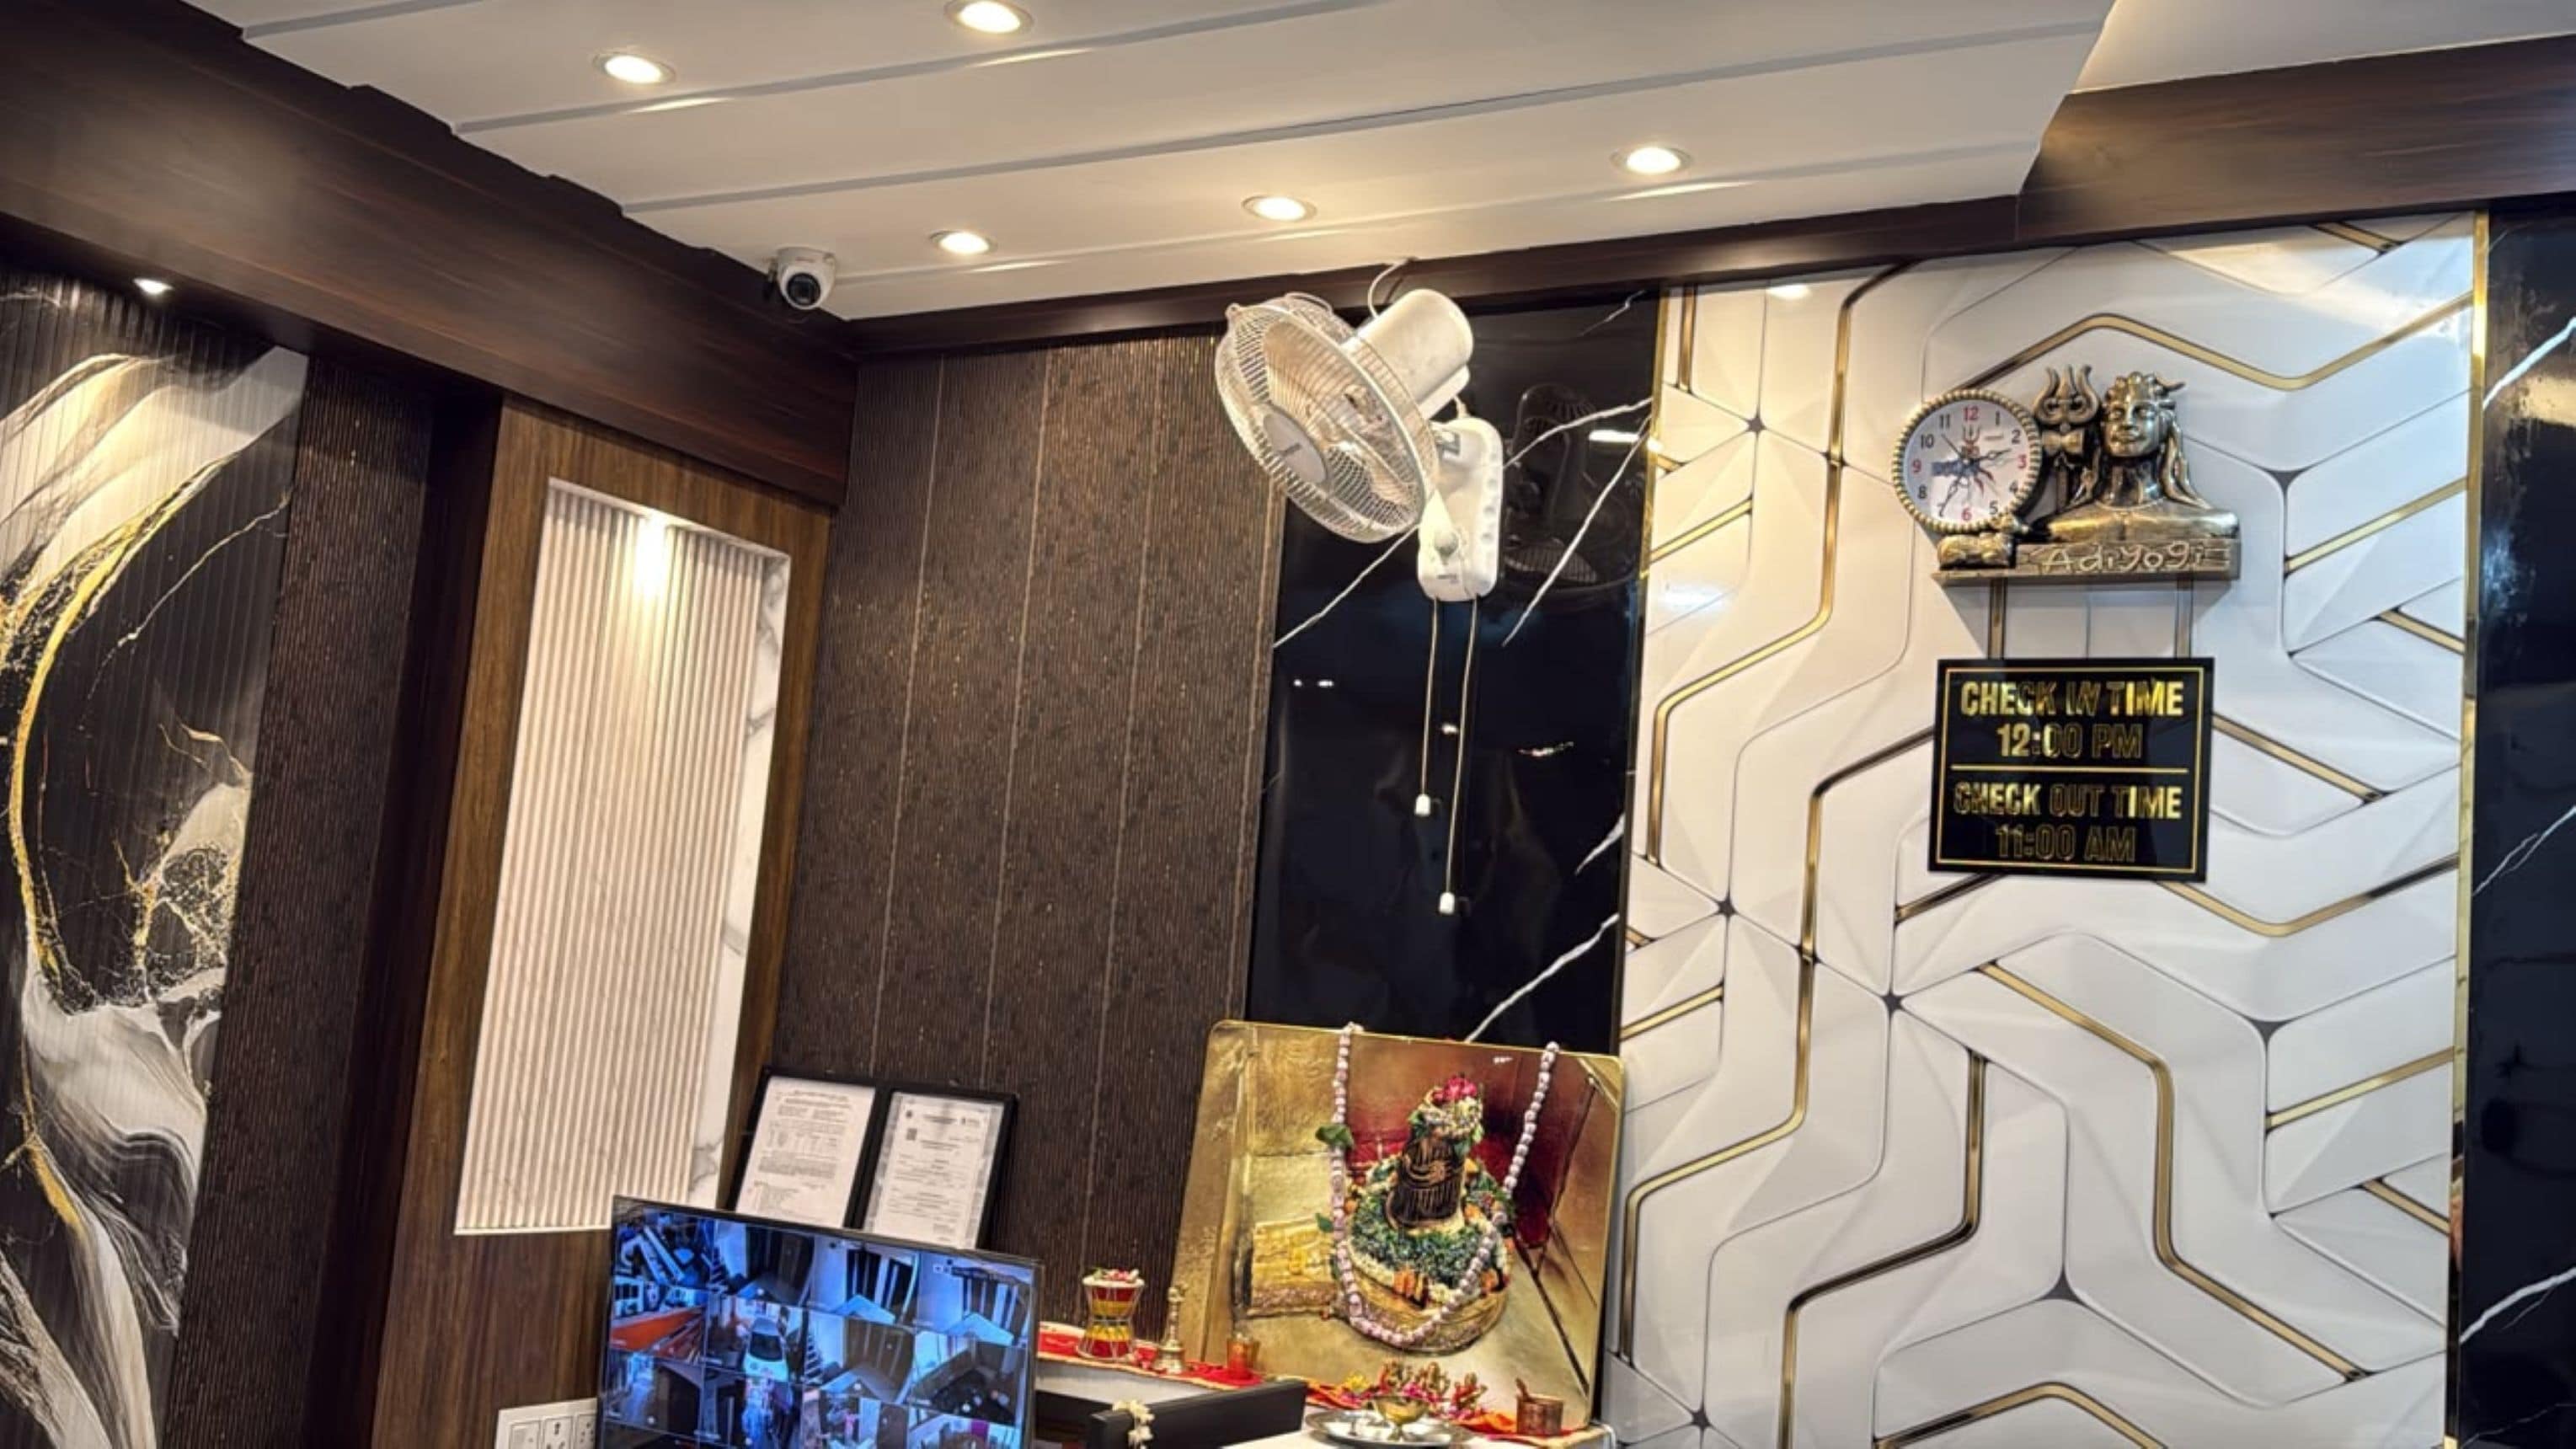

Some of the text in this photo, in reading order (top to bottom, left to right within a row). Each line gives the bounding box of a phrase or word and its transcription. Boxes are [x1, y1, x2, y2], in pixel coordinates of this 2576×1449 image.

[1964, 406, 1979, 421] 12
[1995, 411, 2001, 425] 1
[1939, 414, 1951, 429] 11
[1920, 434, 1934, 449] 10
[2011, 430, 2021, 444] 2
[1912, 459, 1921, 473] 9
[2018, 454, 2027, 468] 3
[1917, 484, 1927, 499] 8
[1961, 507, 1972, 521] 6
[1989, 500, 1998, 515] 5
[1960, 681, 2184, 716] CHECK IN TIME
[1996, 723, 2143, 758] 12:00 PM
[1953, 782, 2183, 819] CHECK OUT TIME
[1996, 824, 2135, 863] 11:00 AM
